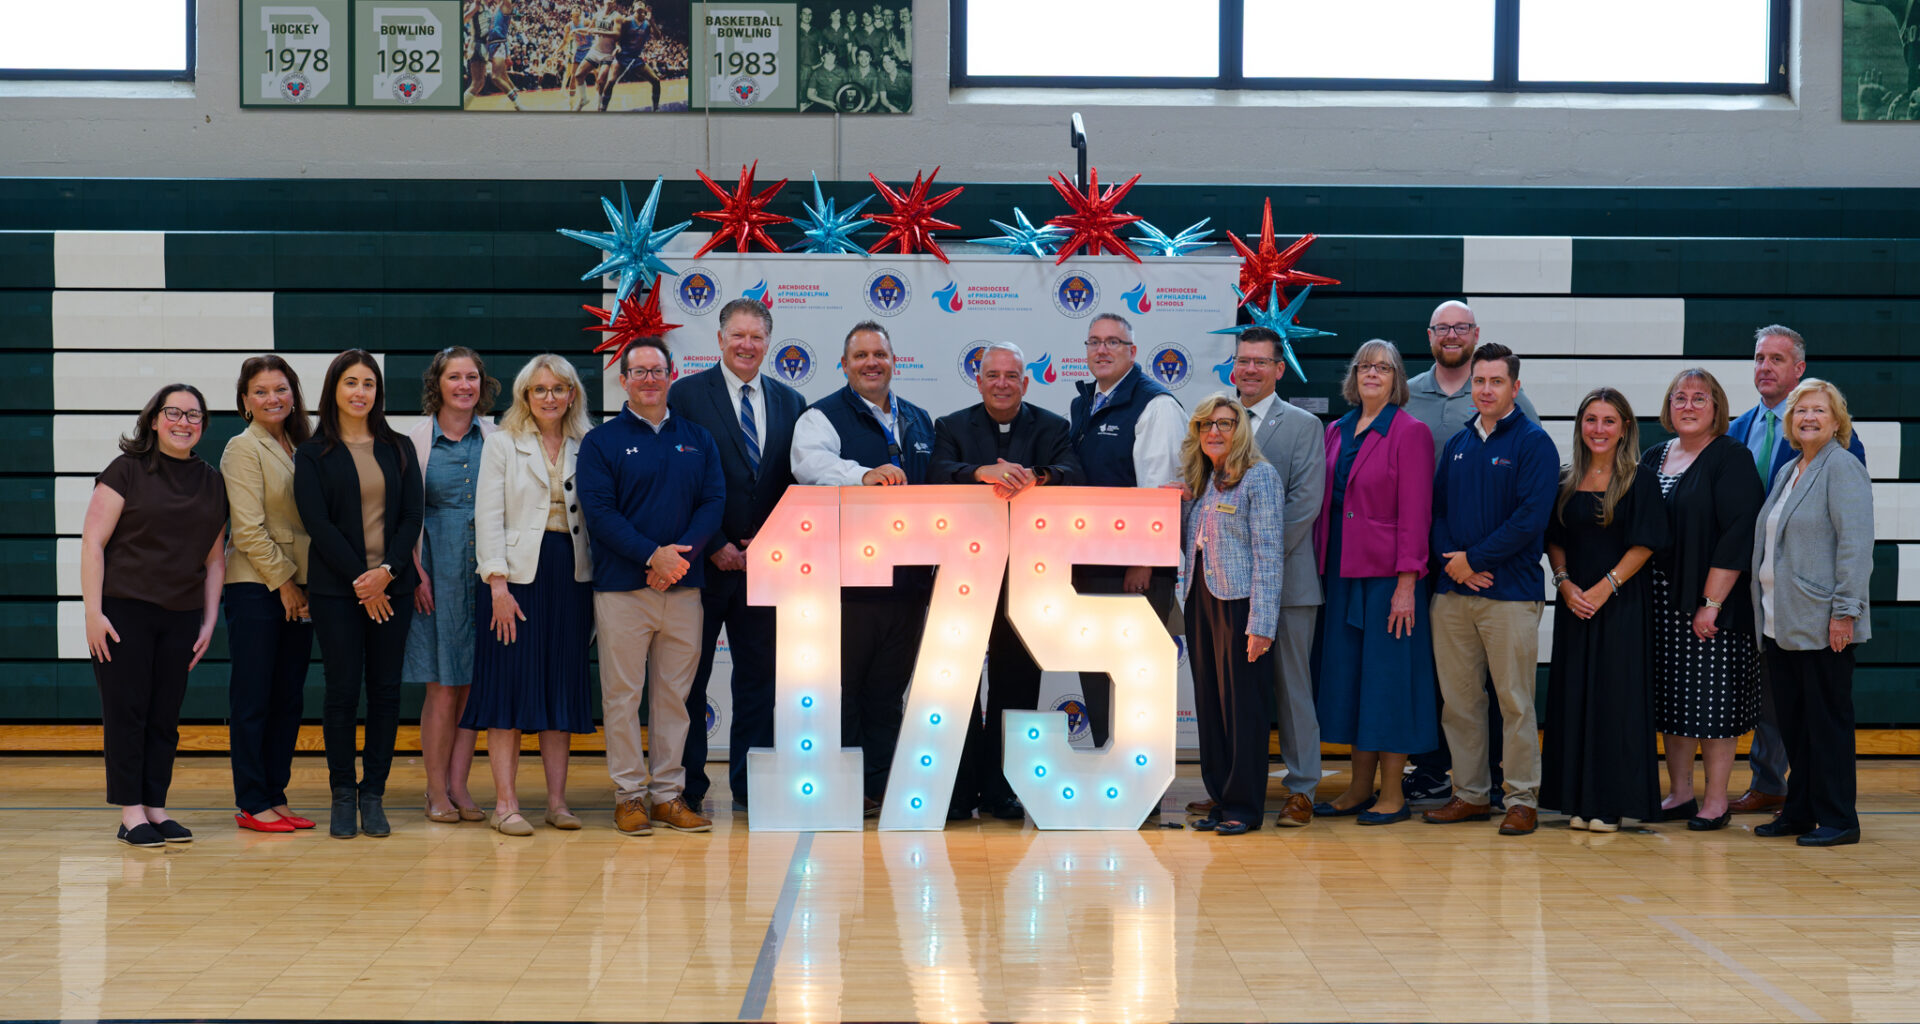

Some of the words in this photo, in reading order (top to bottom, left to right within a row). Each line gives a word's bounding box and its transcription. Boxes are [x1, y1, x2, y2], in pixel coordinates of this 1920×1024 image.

[271, 24, 320, 35] HOCKEY
[705, 16, 783, 27] BASKETBALL
[381, 25, 435, 36] BOWLING
[717, 27, 772, 38] BOWLING
[265, 48, 329, 73] 1978
[377, 49, 441, 73] 1982
[714, 51, 777, 76] 1983
[746, 484, 1182, 832] 175
